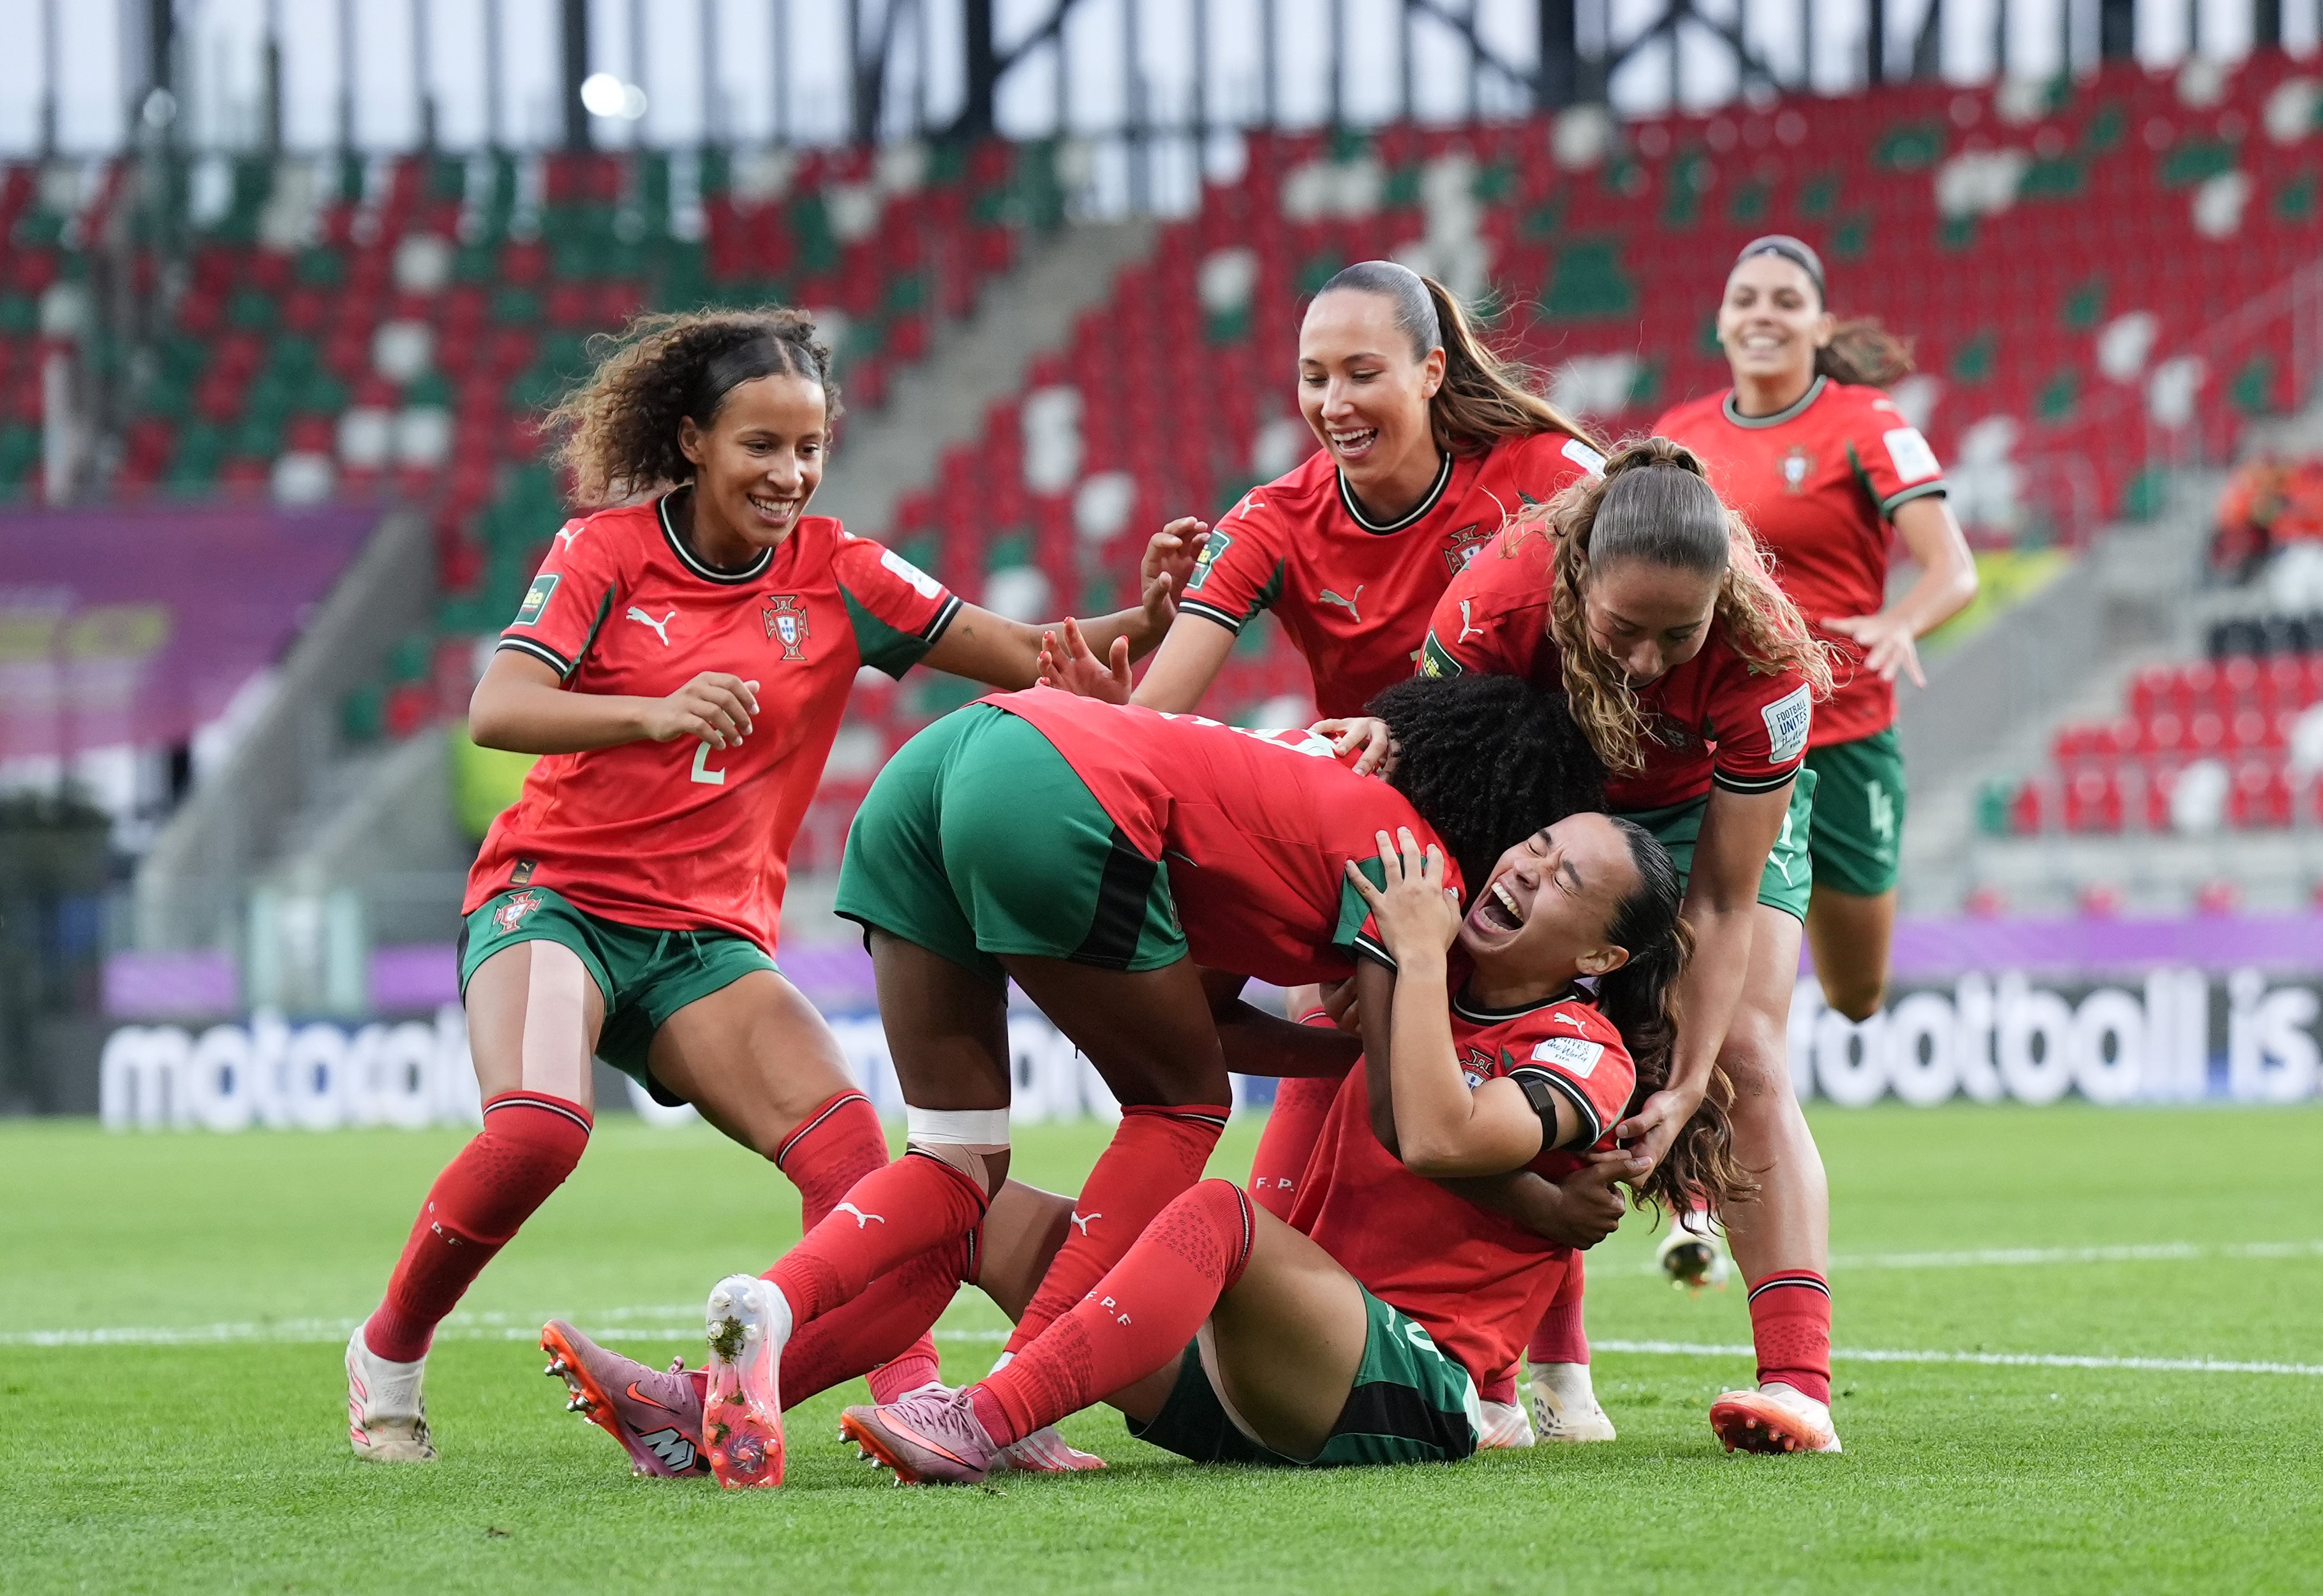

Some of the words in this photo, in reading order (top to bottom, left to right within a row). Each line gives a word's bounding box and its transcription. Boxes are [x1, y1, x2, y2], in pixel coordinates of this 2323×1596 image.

[1776, 699, 1806, 723] FOOTBALL
[1779, 708, 1807, 735] UNITES
[2227, 967, 2321, 1102] is
[1555, 1054, 1570, 1062] FIFA
[1562, 1046, 1589, 1063] World
[99, 1004, 484, 1132] motorol
